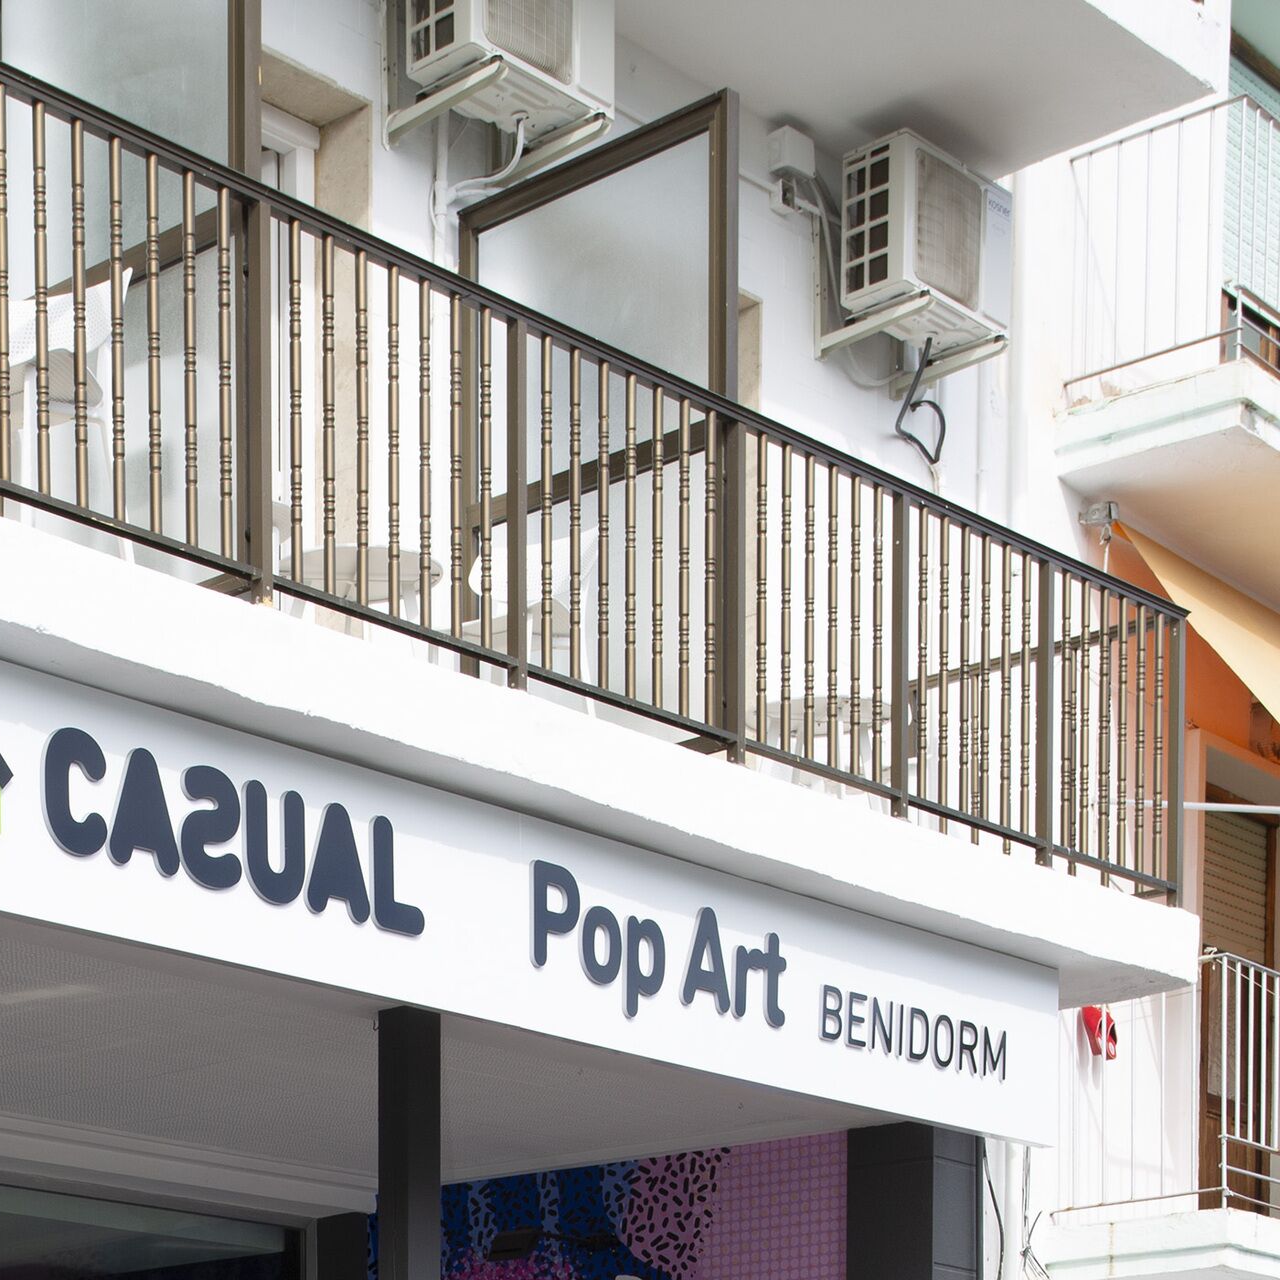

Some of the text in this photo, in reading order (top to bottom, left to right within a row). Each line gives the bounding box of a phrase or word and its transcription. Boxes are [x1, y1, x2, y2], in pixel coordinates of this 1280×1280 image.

[41, 727, 426, 938] CASUAL
[530, 859, 1008, 1082] Pop Art BENIDORM
